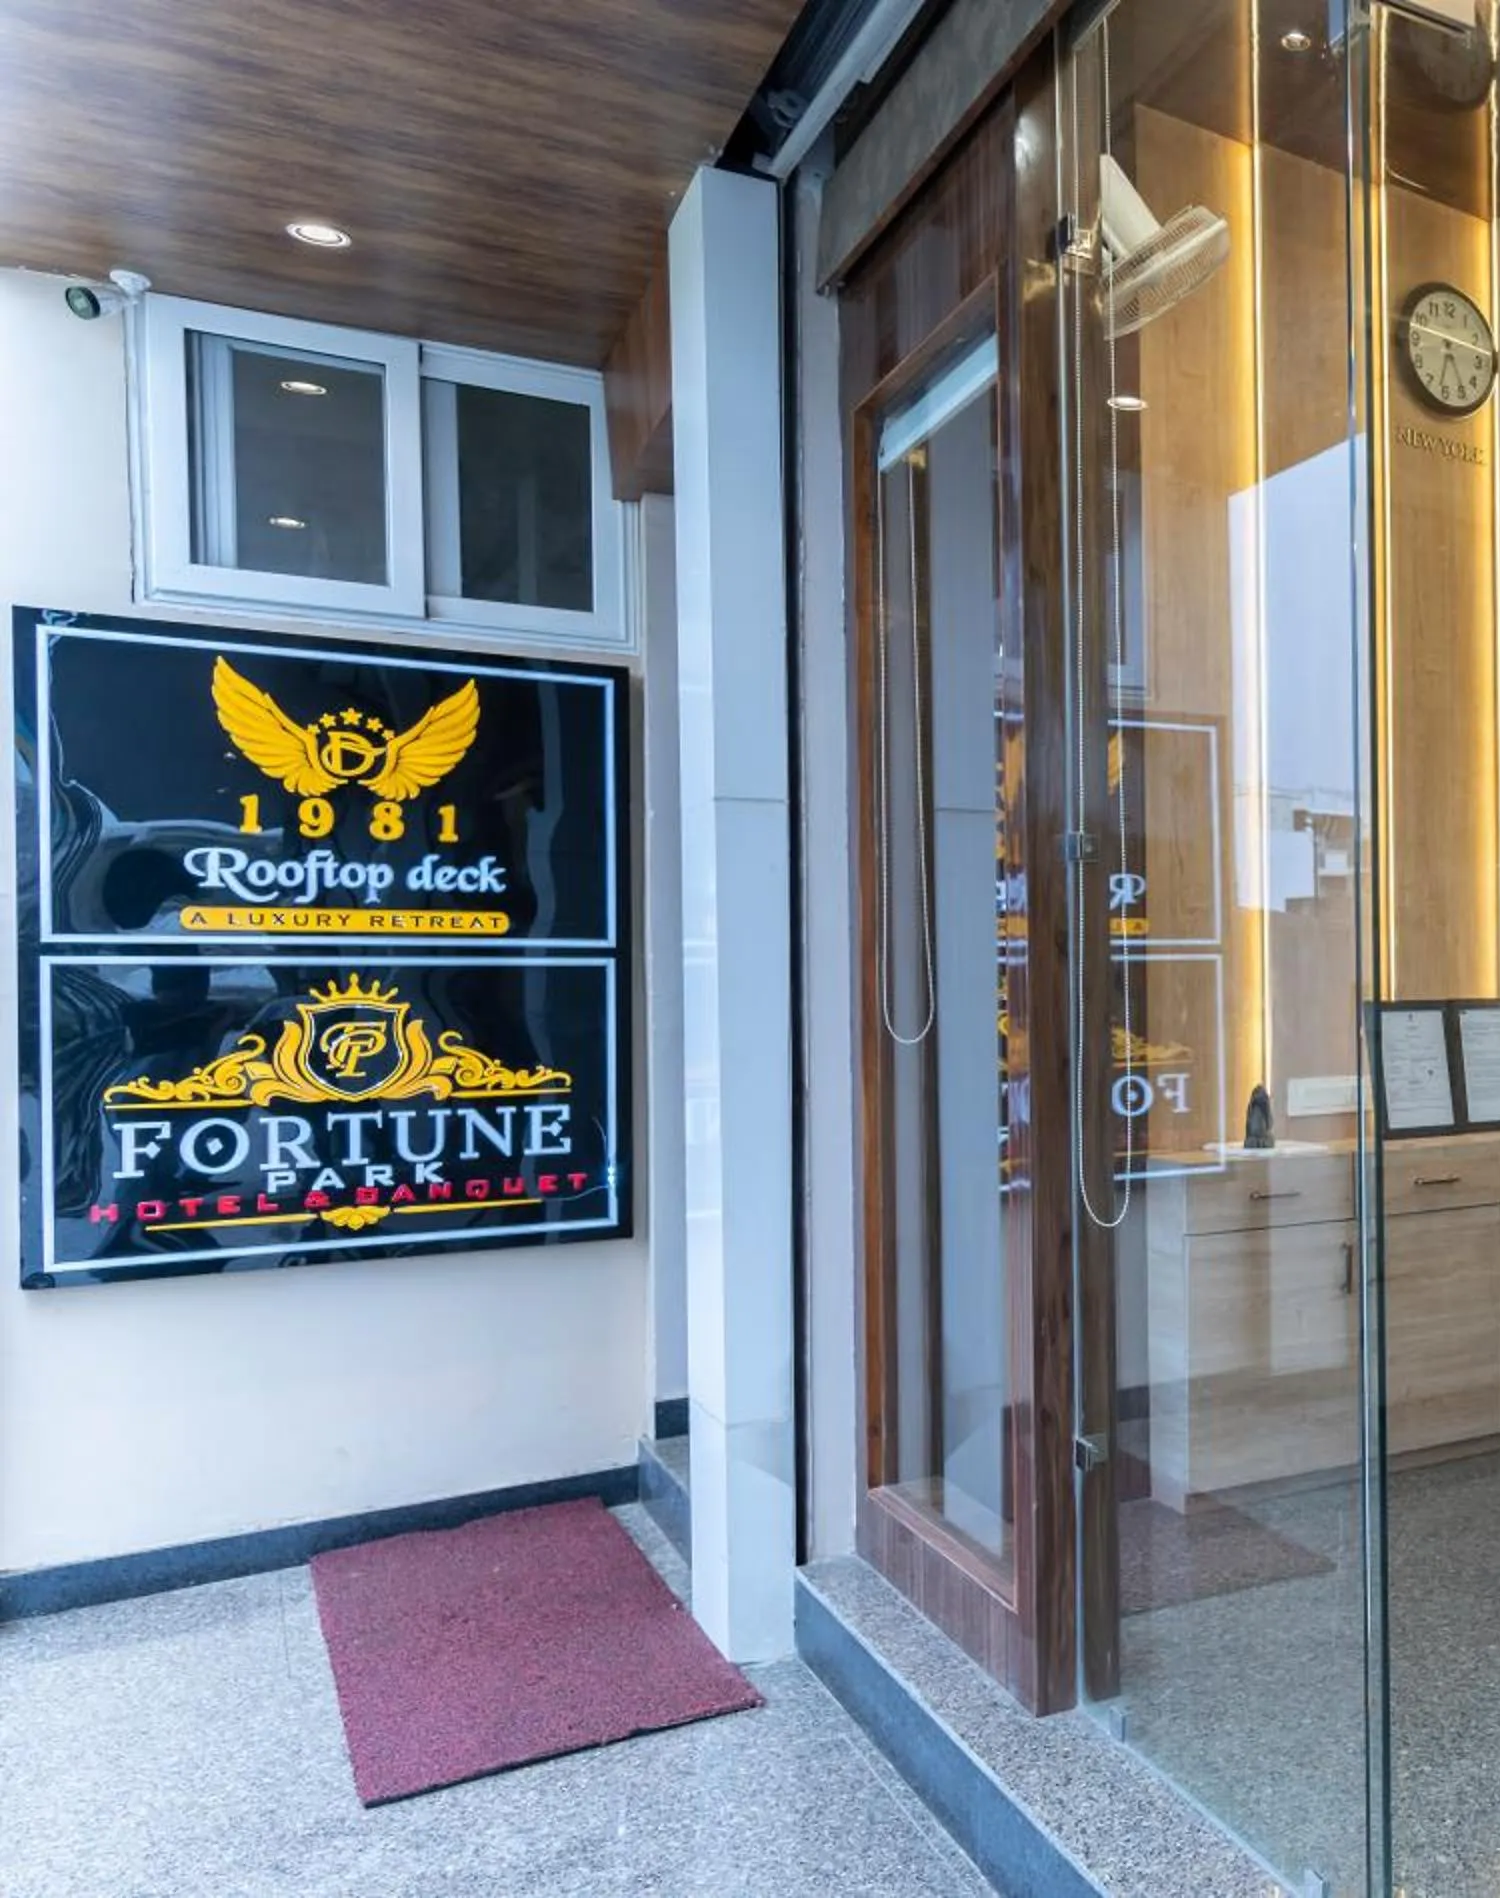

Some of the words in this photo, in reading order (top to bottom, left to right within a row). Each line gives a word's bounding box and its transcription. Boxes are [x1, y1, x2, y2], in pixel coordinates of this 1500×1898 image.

[1443, 302, 1456, 319] 12
[183, 846, 395, 903] Rooftop
[406, 853, 507, 894] deck
[190, 911, 208, 926] A
[227, 912, 351, 927] LUXURY
[369, 914, 503, 929] RETREAT
[112, 1103, 573, 1179] FORTUNE
[267, 1160, 445, 1193] PARK
[89, 1192, 280, 1224] HOTEL
[303, 1188, 330, 1208] &
[355, 1172, 588, 1207] BANQUET
